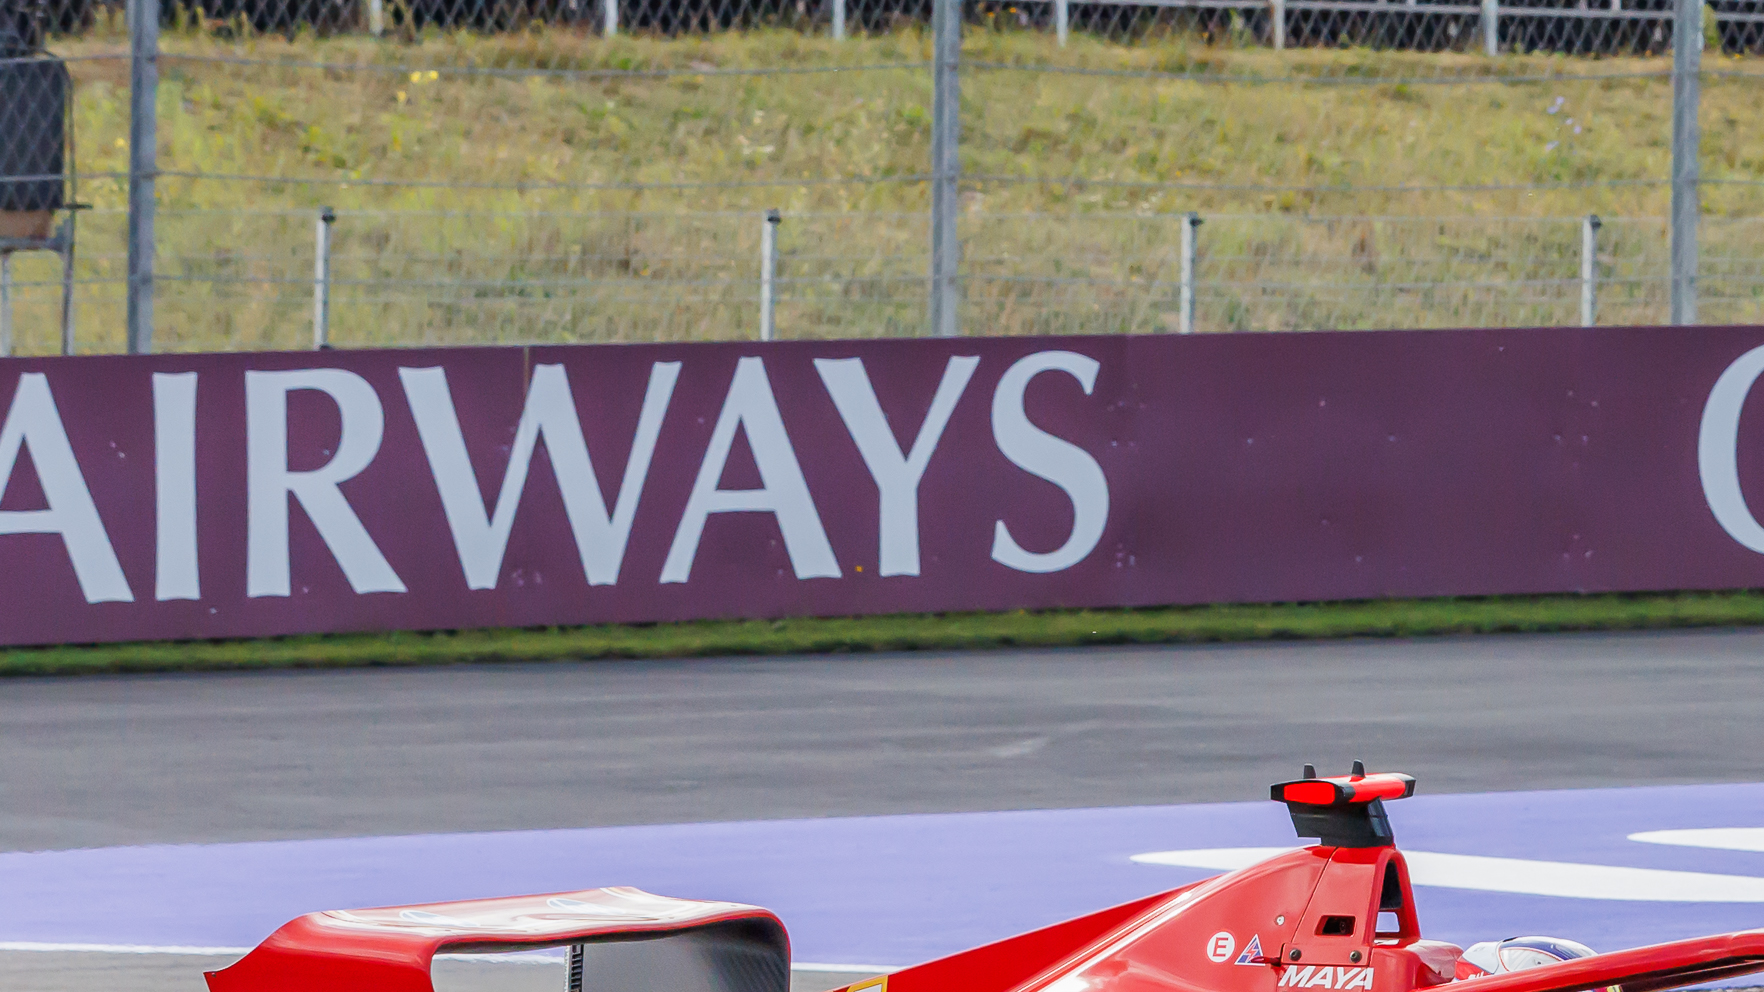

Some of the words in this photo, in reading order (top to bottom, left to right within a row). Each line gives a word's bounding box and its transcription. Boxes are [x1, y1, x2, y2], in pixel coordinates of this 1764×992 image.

[0, 351, 1111, 603] AIRWAYS
[1213, 936, 1229, 959] E
[1277, 964, 1376, 991] MAYA
